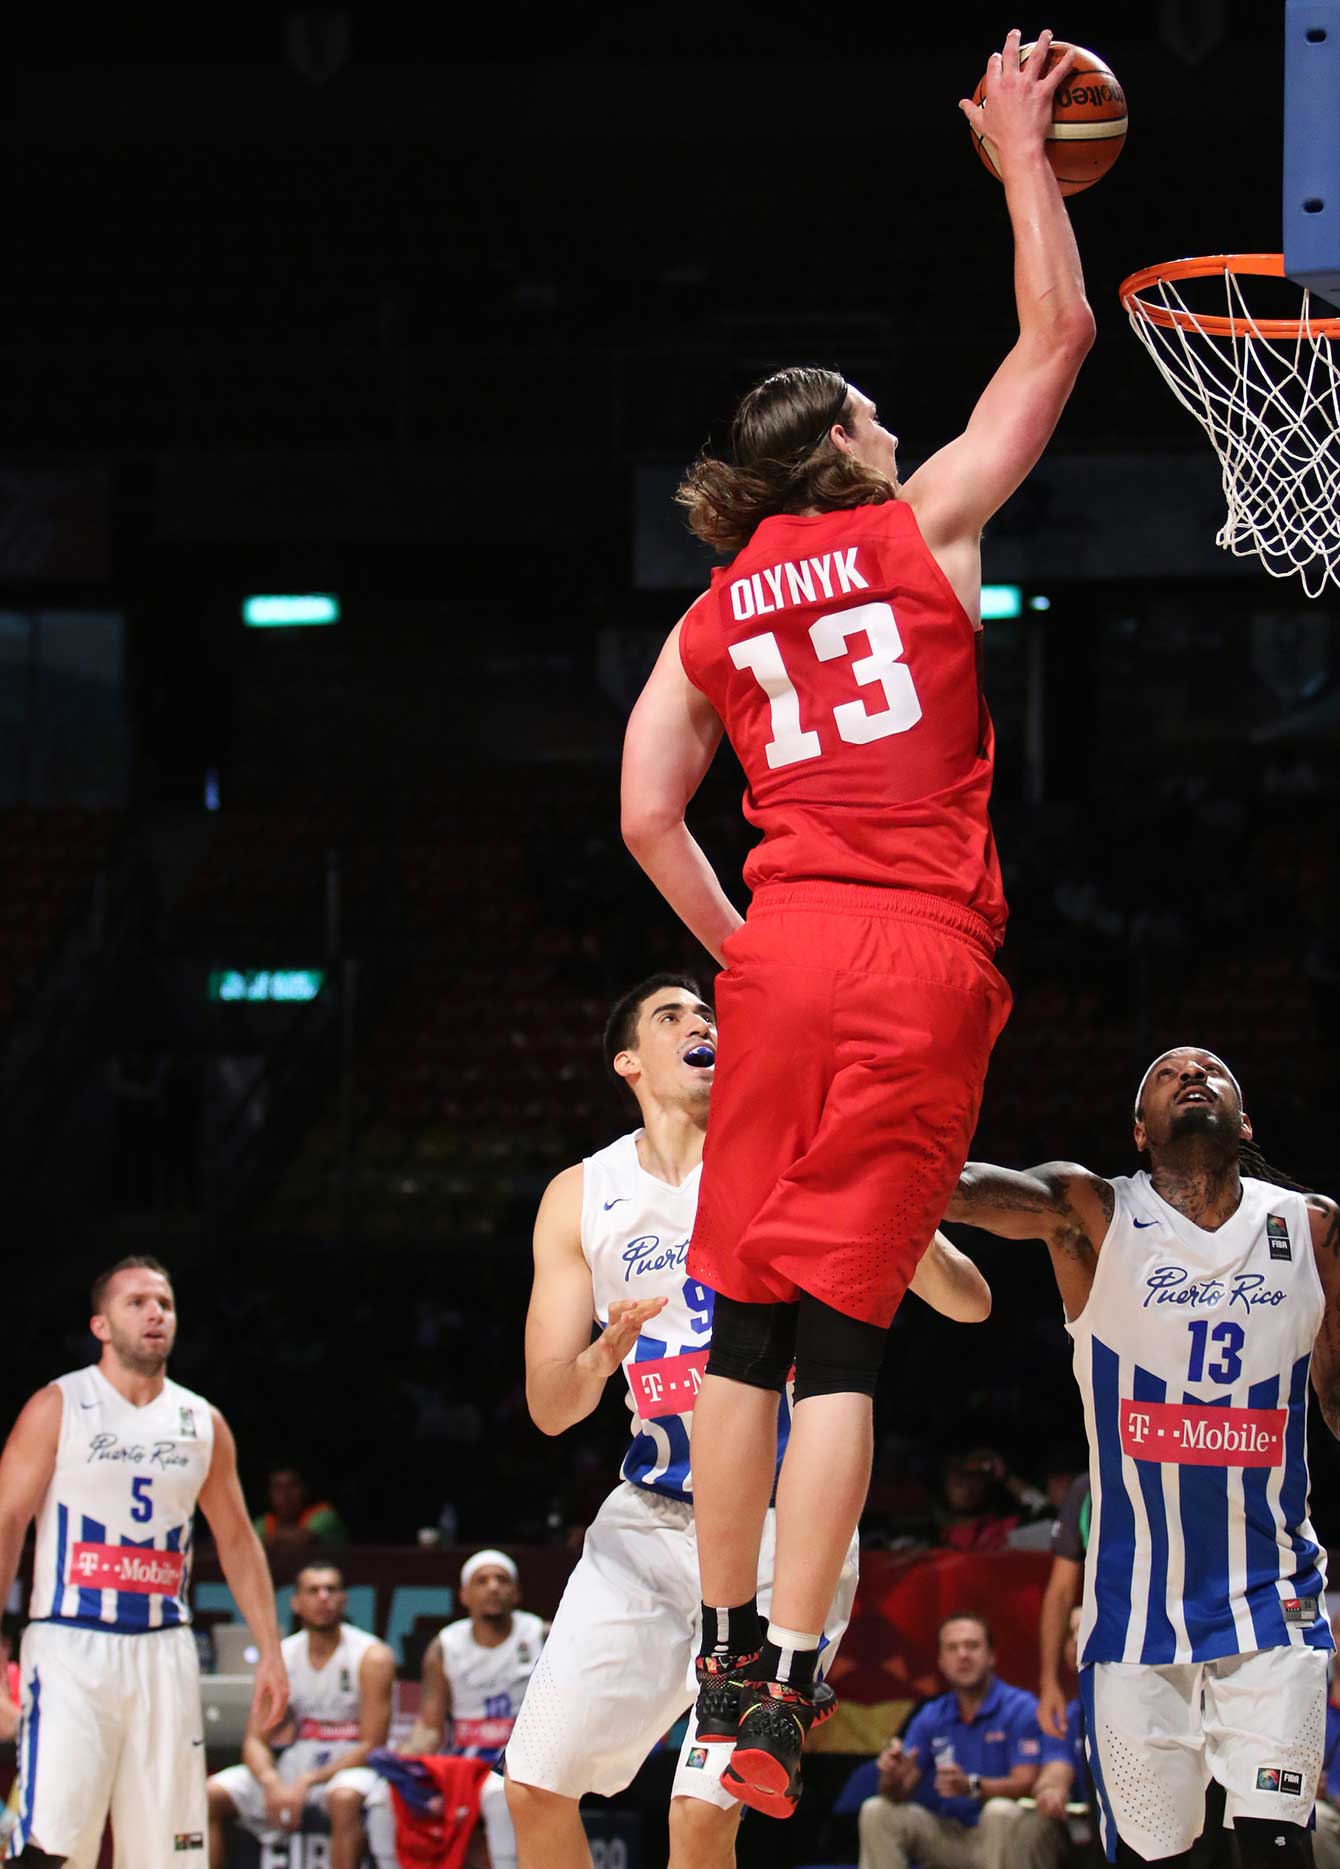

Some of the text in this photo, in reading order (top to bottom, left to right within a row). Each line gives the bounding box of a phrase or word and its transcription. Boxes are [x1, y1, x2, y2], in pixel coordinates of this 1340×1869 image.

[729, 546, 870, 622] OLYNYK
[727, 601, 923, 770] 13
[622, 1235, 690, 1283] Puert
[682, 1277, 716, 1335] 9
[1143, 1265, 1287, 1315] Puerto Rico
[1187, 1319, 1246, 1385] 13
[87, 1433, 189, 1470] Puerto Rico
[130, 1476, 153, 1523] 5
